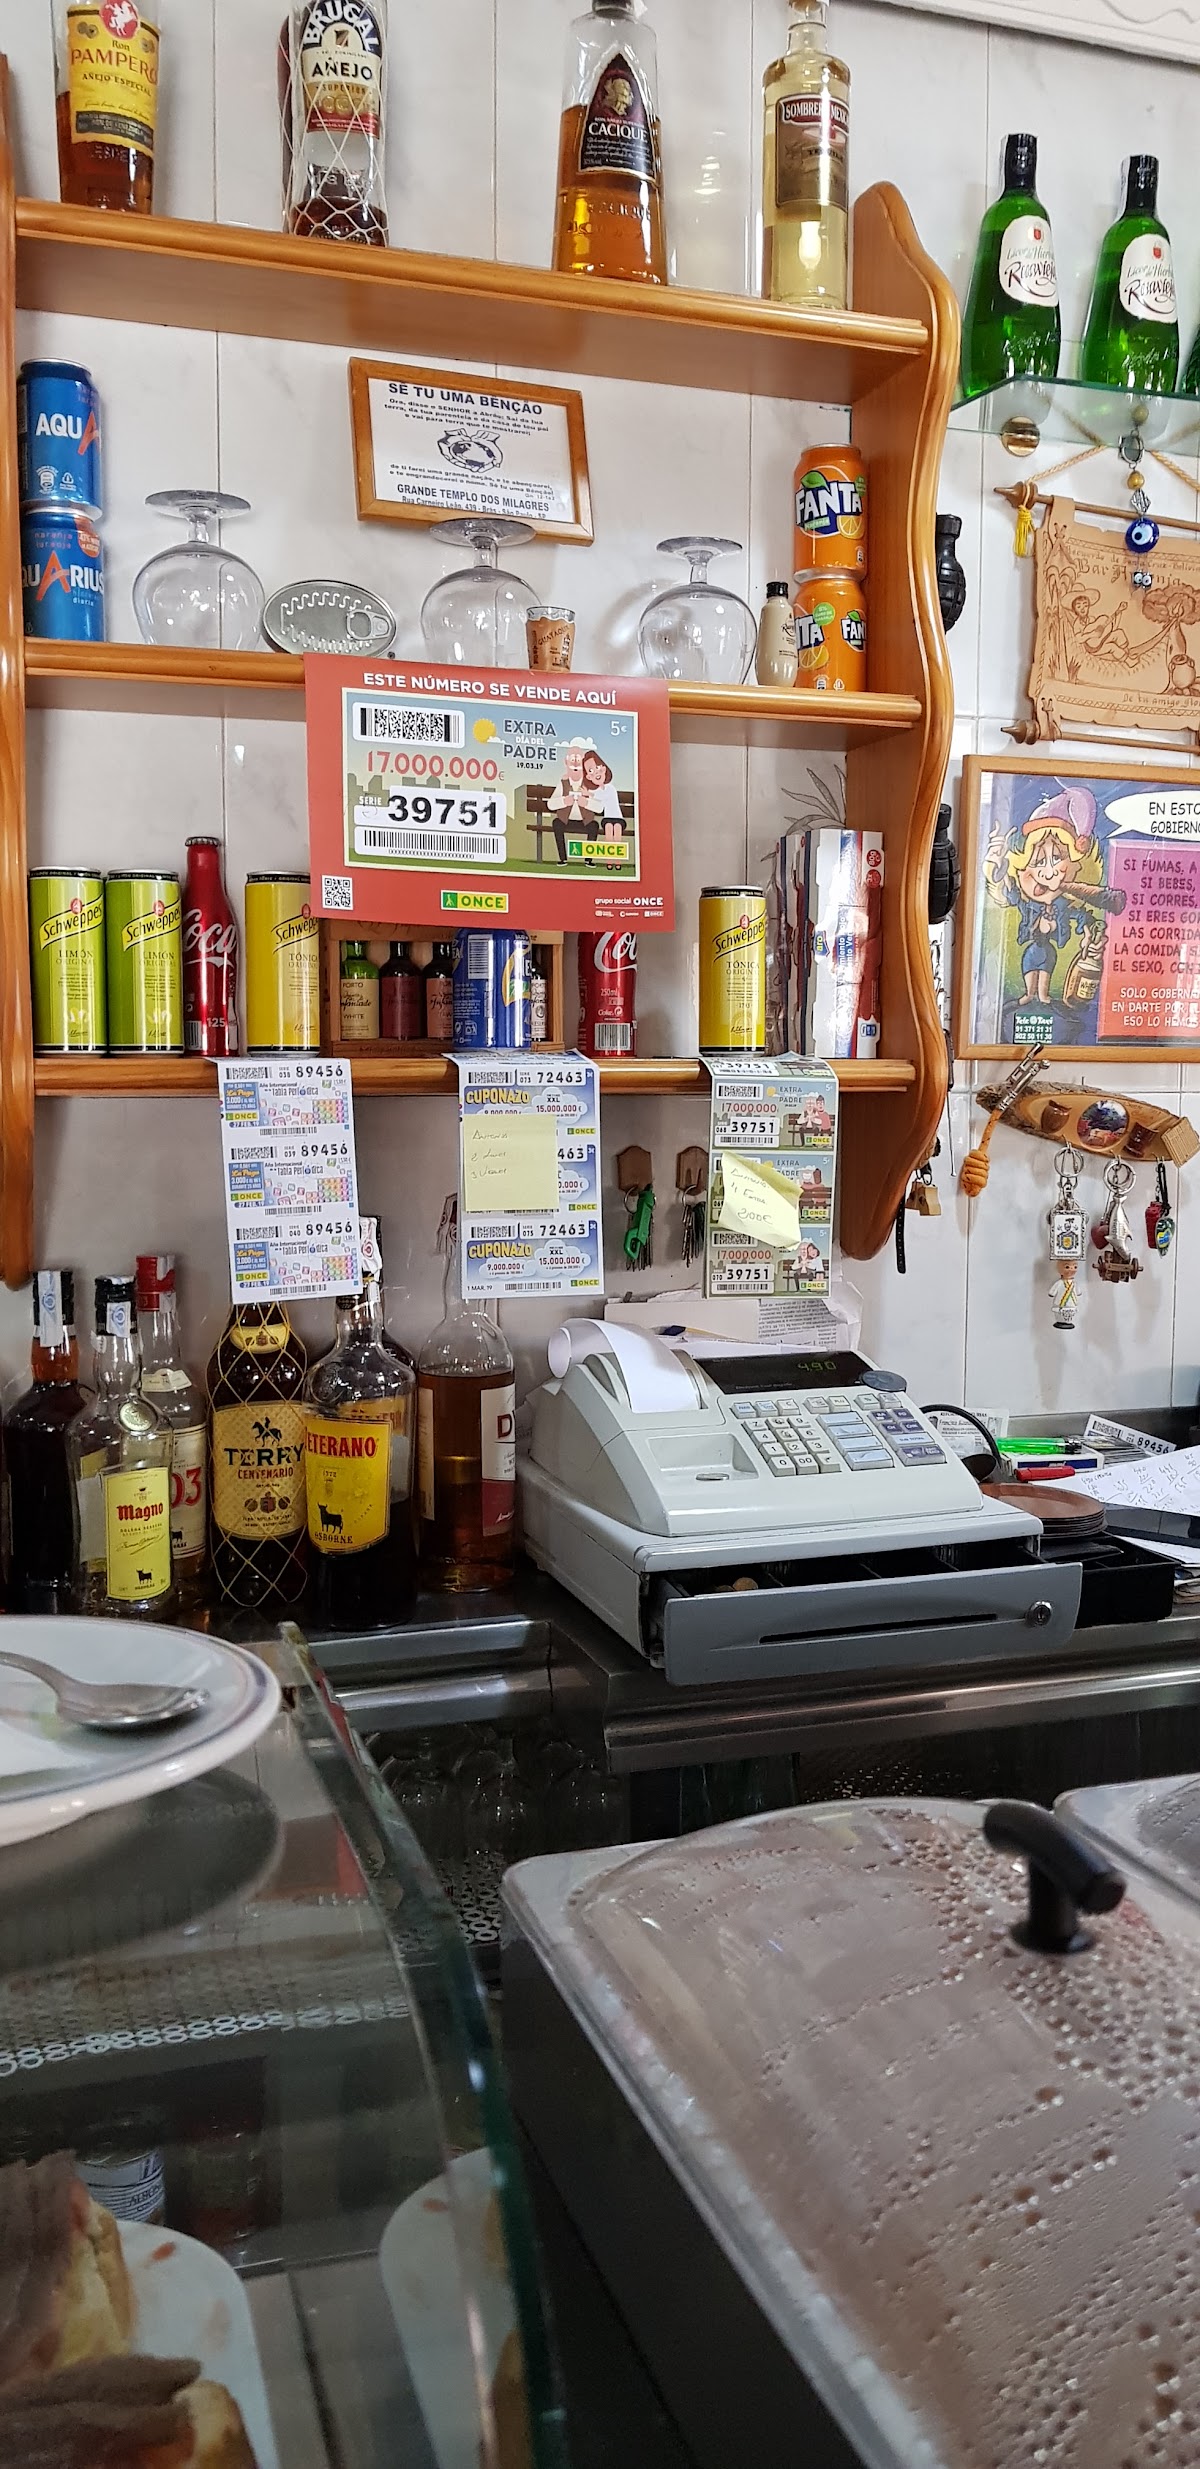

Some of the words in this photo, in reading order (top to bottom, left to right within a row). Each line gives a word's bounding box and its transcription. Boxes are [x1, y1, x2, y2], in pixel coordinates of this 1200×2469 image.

[303, 1, 379, 51] BRUGAL
[112, 40, 130, 52] Ron
[71, 48, 157, 84] PAMPERO
[312, 57, 372, 80] AÑEJO
[588, 122, 649, 141] CACIQUE
[413, 386, 434, 399] TU
[440, 390, 475, 405] UMA
[397, 484, 437, 498] GRANDE
[440, 489, 478, 503] TEMPLO
[481, 493, 500, 505] DOS
[503, 497, 549, 512] MILAGRES
[795, 481, 862, 525] FANTA
[364, 672, 407, 688] ESTE
[411, 675, 485, 694] NÚMERO
[489, 683, 510, 697] SE
[514, 685, 571, 701] VENDE
[575, 690, 617, 706] AQUÍ
[504, 720, 557, 737] EXTRA
[610, 721, 627, 736] 5€
[531, 737, 545, 746] DEL
[503, 744, 557, 761] PADRE
[516, 762, 543, 770] 19.03.19
[359, 795, 382, 806] SERIE
[388, 795, 497, 828] 39751
[1149, 802, 1166, 815] EN
[586, 844, 625, 857] ONCE
[1124, 859, 1136, 871] SI
[1189, 861, 1198, 874] A
[1141, 877, 1153, 889] SI
[461, 895, 504, 909] ONCE
[595, 897, 614, 906] grupo
[614, 896, 632, 905] social
[633, 897, 664, 906] ONCE
[1132, 893, 1145, 906] SI
[1150, 894, 1198, 909] CORRES,
[1128, 910, 1141, 922] SI
[1147, 910, 1175, 923] ERES
[1122, 926, 1144, 939] LAS
[1114, 943, 1129, 955] LA
[1113, 960, 1126, 972] EL
[1131, 961, 1165, 975] SEXO,
[1120, 987, 1147, 999] SOLO
[1111, 1001, 1125, 1013] EN
[1129, 1002, 1161, 1013] DARTE
[207, 1018, 226, 1028] 125
[1123, 1015, 1144, 1026] ESO
[1147, 1016, 1160, 1027] LO
[296, 1065, 343, 1078] 89456
[537, 1071, 583, 1083] 72463
[465, 1087, 530, 1104] CUPONAZO
[536, 1105, 577, 1113] 15.000.000
[234, 1112, 257, 1120] ONCE
[731, 1121, 774, 1133] 39751
[301, 1143, 348, 1157] 89456
[240, 1192, 262, 1200] ONCE
[306, 1221, 352, 1236] 89456
[540, 1223, 586, 1236] 72463
[468, 1241, 532, 1259] CUPONAZO
[539, 1257, 580, 1265] 15.000.000
[244, 1272, 268, 1280] ONCE
[727, 1269, 769, 1280] 39751
[305, 1431, 377, 1458] ETERANO
[1137, 1437, 1169, 1454] 89456
[224, 1443, 305, 1466] TERRY
[238, 1467, 294, 1480] CENTENARIO
[116, 1502, 164, 1522] Magno
[315, 1531, 354, 1544] OSBORNE
